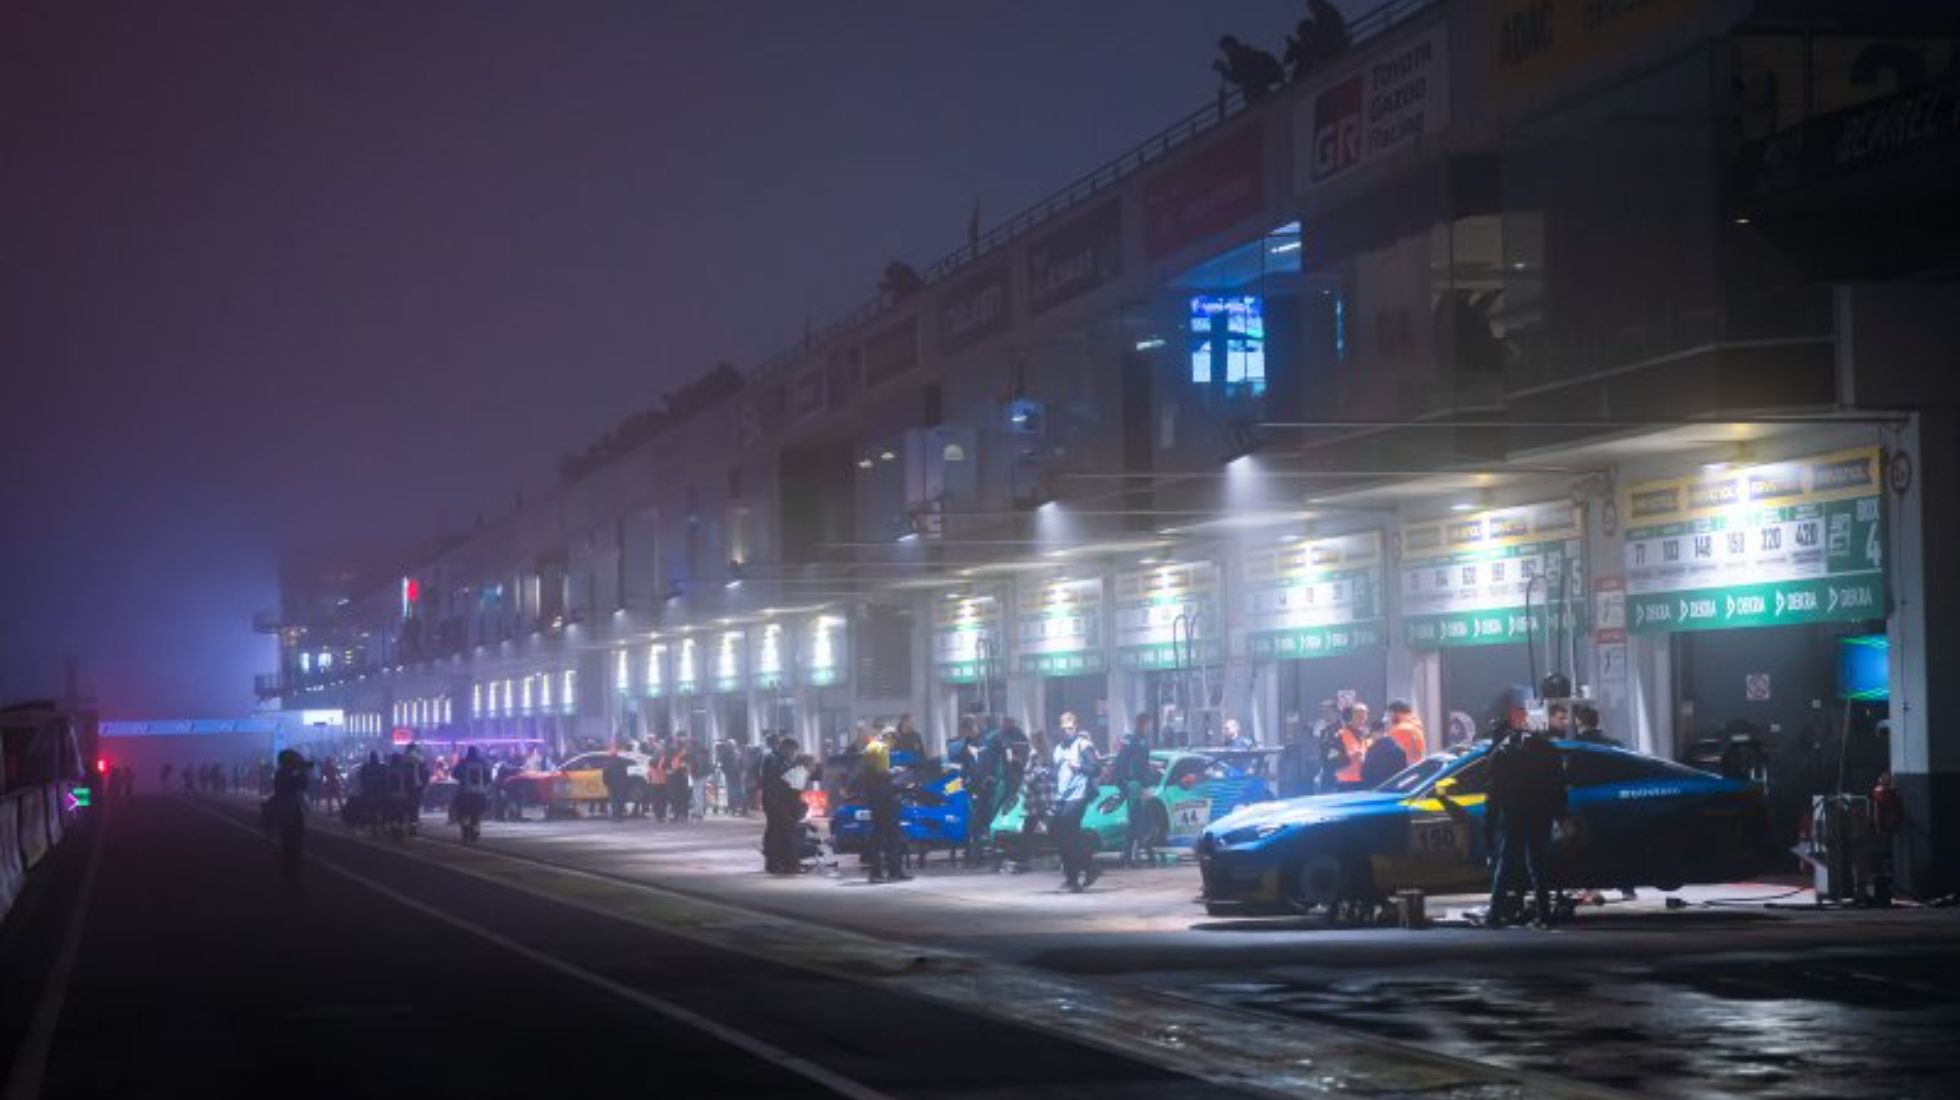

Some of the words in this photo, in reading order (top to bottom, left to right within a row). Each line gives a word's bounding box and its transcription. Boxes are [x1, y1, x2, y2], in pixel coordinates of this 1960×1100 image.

[1372, 41, 1432, 91] TOYOTA
[1865, 521, 1882, 567] 4
[1787, 591, 1818, 611] DEKRA
[1841, 586, 1874, 608] DEKRA
